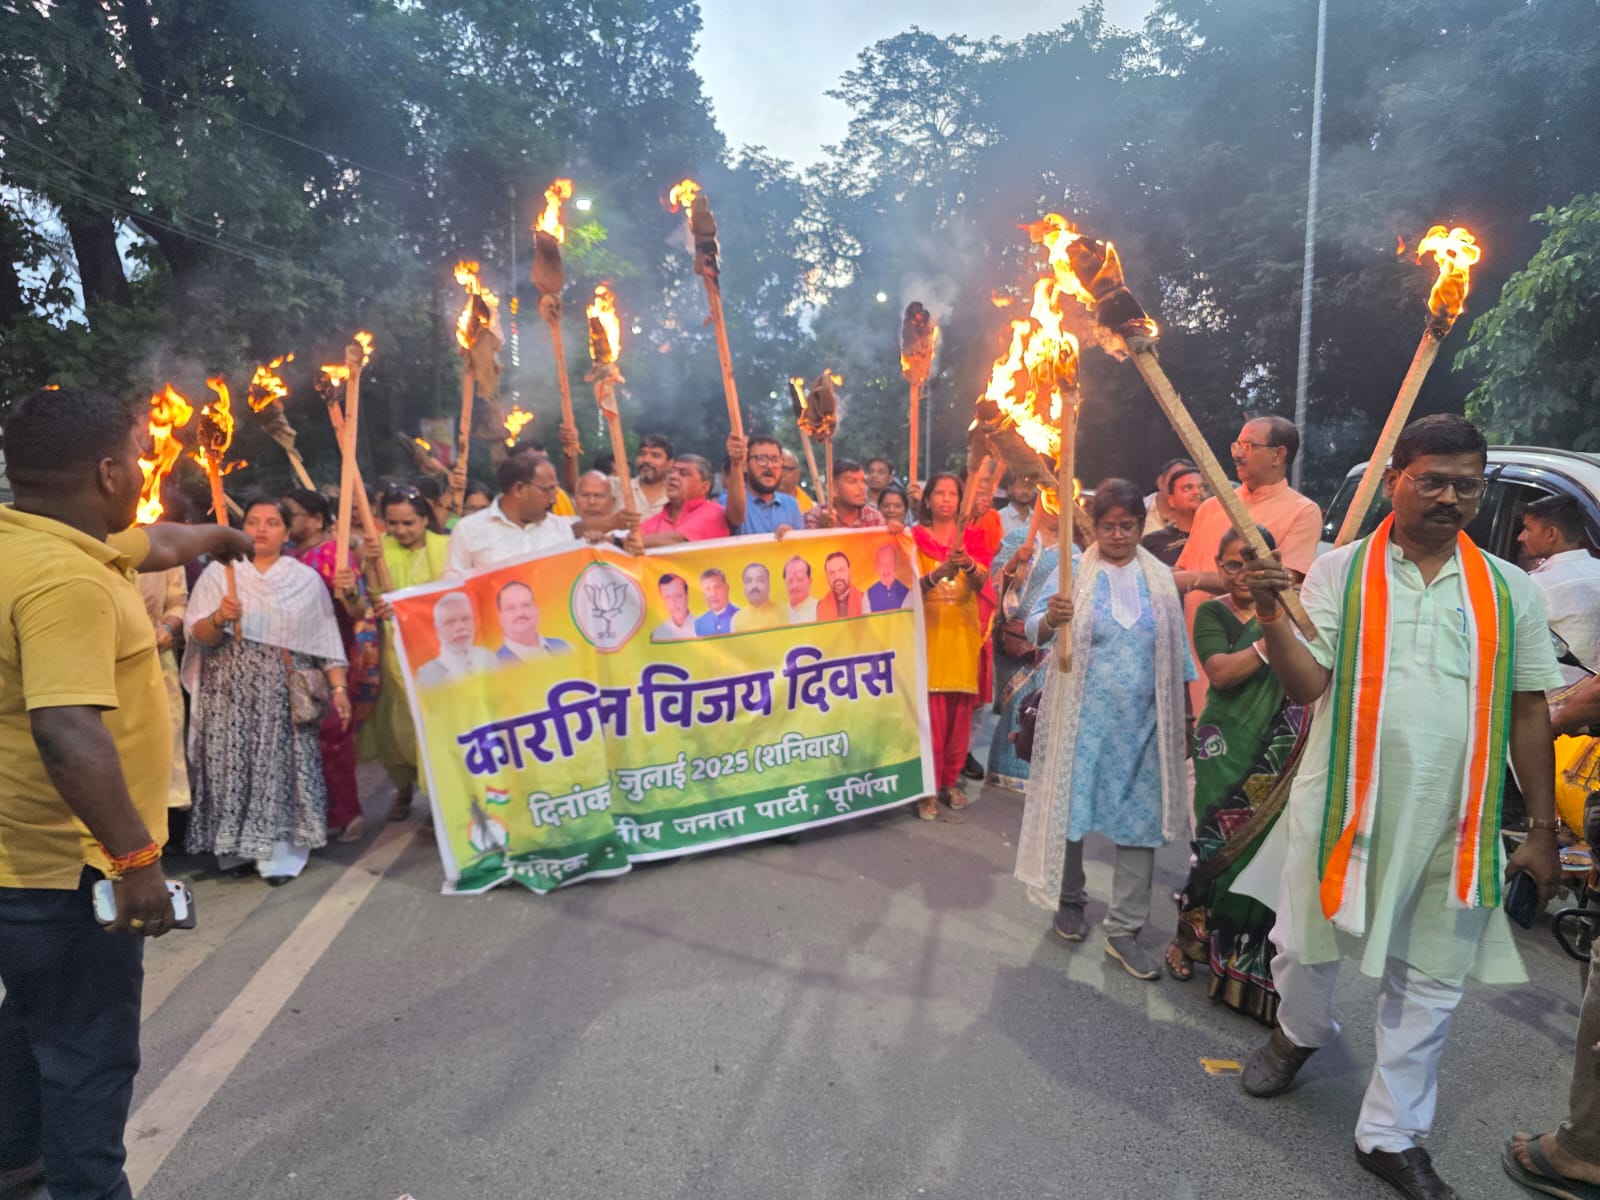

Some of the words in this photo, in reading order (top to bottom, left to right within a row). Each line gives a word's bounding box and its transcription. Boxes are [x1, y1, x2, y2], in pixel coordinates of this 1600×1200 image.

[638, 663, 775, 733] विजय
[783, 646, 896, 712] दिवस
[616, 752, 687, 801] जुलाई
[691, 750, 749, 781] 2025
[755, 731, 850, 772] (शनिवार)
[673, 806, 746, 836] जनता
[826, 772, 900, 812] पूर्णिया
